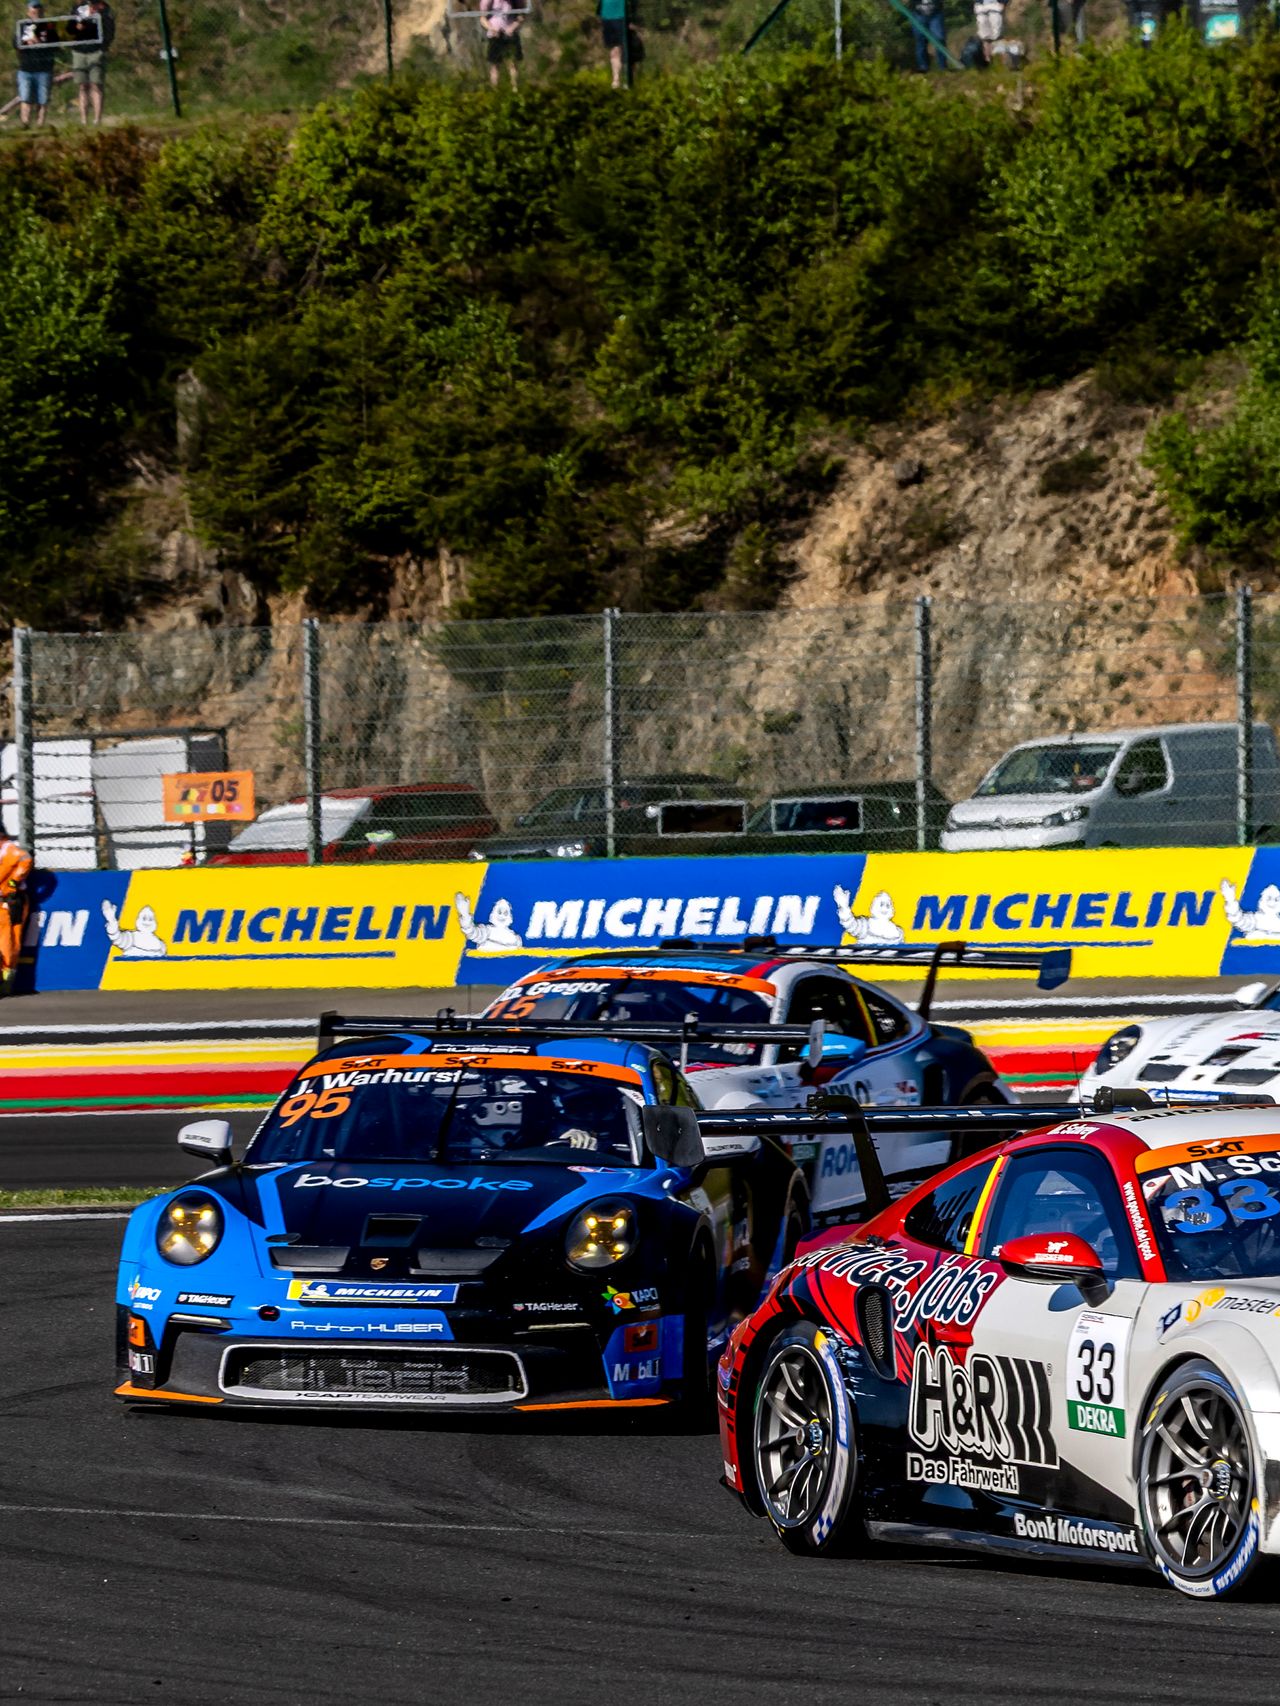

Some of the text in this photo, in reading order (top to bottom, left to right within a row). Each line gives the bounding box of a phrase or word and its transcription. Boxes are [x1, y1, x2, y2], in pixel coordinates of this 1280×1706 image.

[212, 780, 239, 802] 05
[172, 905, 451, 944] MICHELIN
[526, 895, 821, 940] MICHELIN
[912, 890, 1214, 931] MICHELIN
[525, 981, 611, 997] Gregor
[290, 1069, 462, 1098] J. Warhurst
[279, 1087, 355, 1128] 95
[293, 1173, 533, 1191] bospoke
[1169, 1161, 1225, 1190] M.
[1164, 1178, 1280, 1233] 33
[334, 1287, 442, 1298] MICHELIN
[291, 1321, 443, 1333] Proton HUBER
[1076, 1339, 1116, 1404] 33
[909, 1342, 1013, 1462] H&R
[1076, 1405, 1118, 1434] DEKRA
[908, 1454, 1018, 1492] Das Fahrwerk!
[1014, 1513, 1139, 1552] Bonk Motorsport
